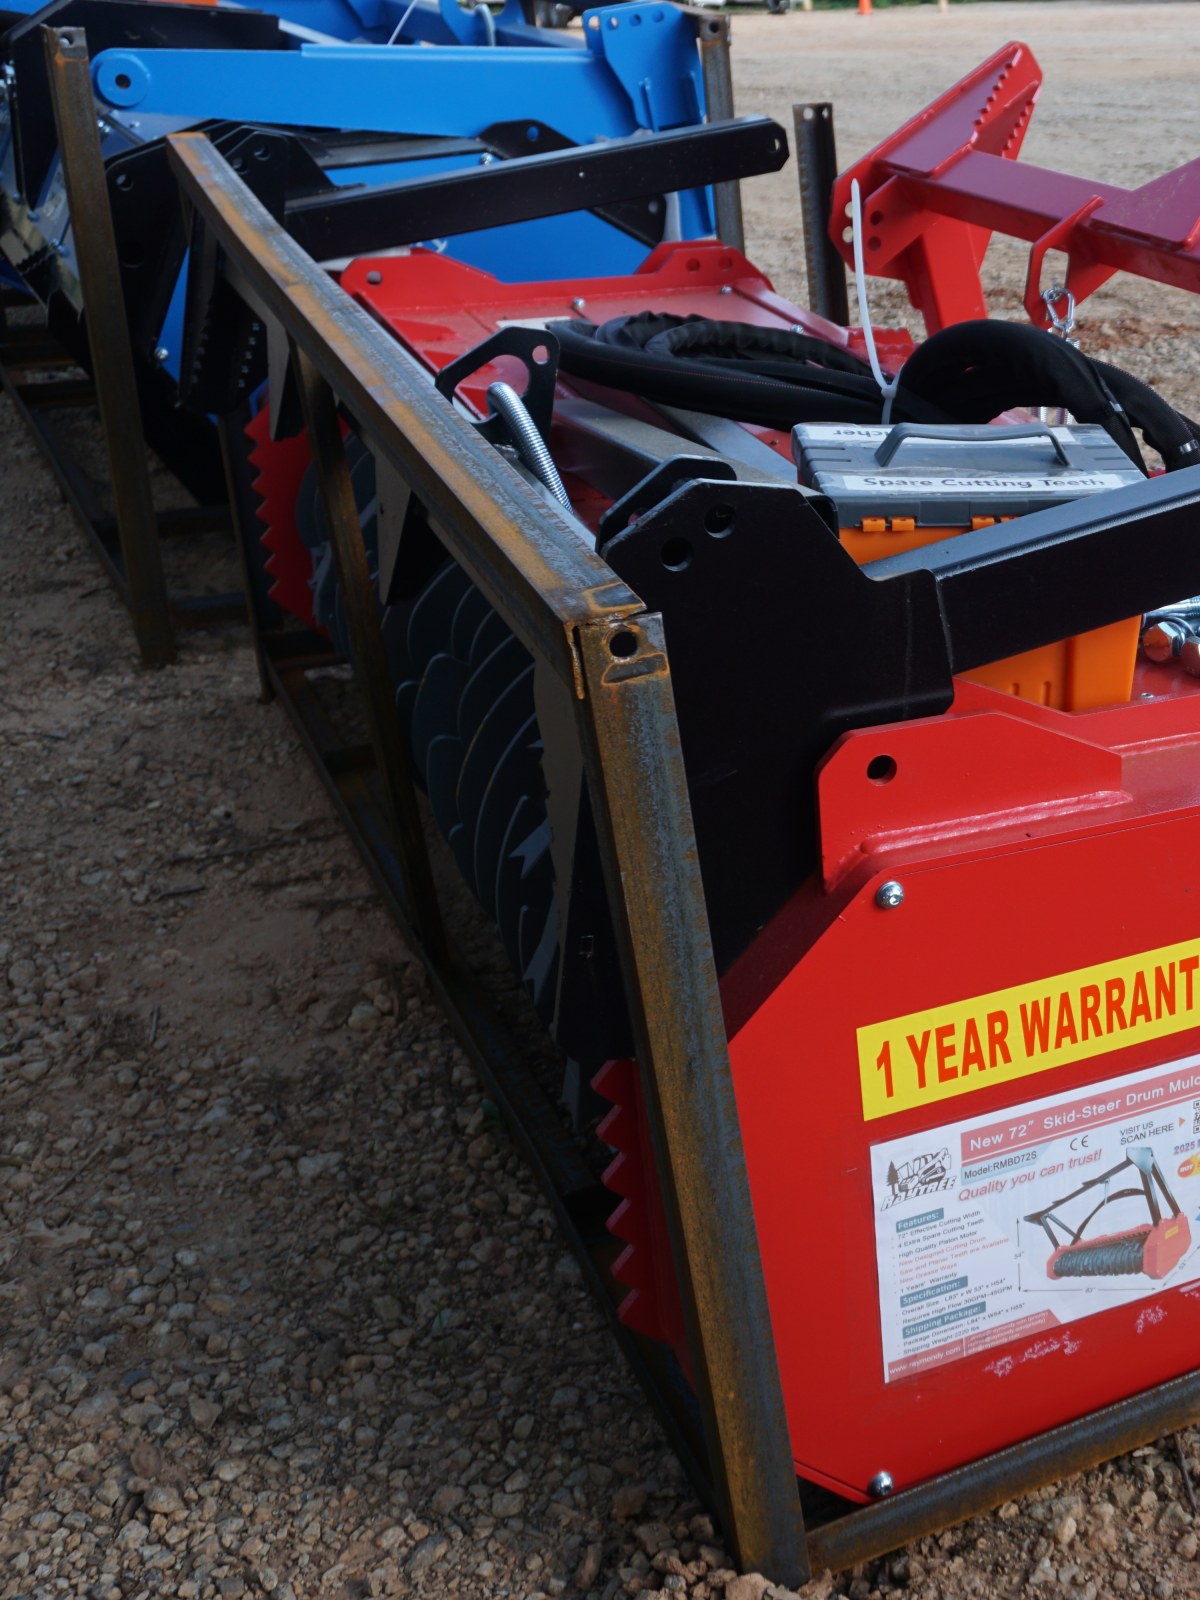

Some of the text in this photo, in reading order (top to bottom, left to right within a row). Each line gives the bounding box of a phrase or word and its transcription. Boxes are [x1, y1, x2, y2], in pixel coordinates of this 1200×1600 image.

[864, 477, 1105, 489] Spare Cutting Teeth
[876, 1041, 893, 1098] 1
[906, 1009, 1012, 1089] YEAR
[969, 1132, 1003, 1151] New
[1043, 1099, 1121, 1129] Skid-Steer
[1126, 1086, 1163, 1106] Drum
[1120, 1120, 1153, 1136] VISIT US
[1120, 1122, 1173, 1145] SCAN HERE
[1173, 1140, 1195, 1155] 2025
[958, 1148, 1102, 1201] Quality you can trust!
[964, 1150, 1036, 1180] Model:RMBD72S
[897, 1212, 938, 1230] Features:
[903, 1238, 920, 1246] Extra
[922, 1232, 940, 1240] Spare
[942, 1224, 964, 1234] Cutting
[967, 1217, 983, 1227] Teeth
[910, 1224, 937, 1235] Effective
[939, 1216, 961, 1226] Cutting
[962, 1209, 980, 1219] Width
[898, 1230, 976, 1258] High Quality Piston Motor
[898, 1236, 985, 1267] New Designed Cutting Drum
[915, 1262, 926, 1270] and
[951, 1250, 967, 1259] Teeth
[899, 1276, 913, 1284] New
[929, 1272, 957, 1284] Warranty
[903, 1281, 959, 1303] Specification:
[901, 1303, 923, 1315] Overall
[902, 1312, 929, 1323] Requires
[931, 1306, 945, 1314] High
[905, 1306, 980, 1335] Shipping Package:
[903, 1334, 929, 1346] Package
[903, 1342, 929, 1354] Shipping
